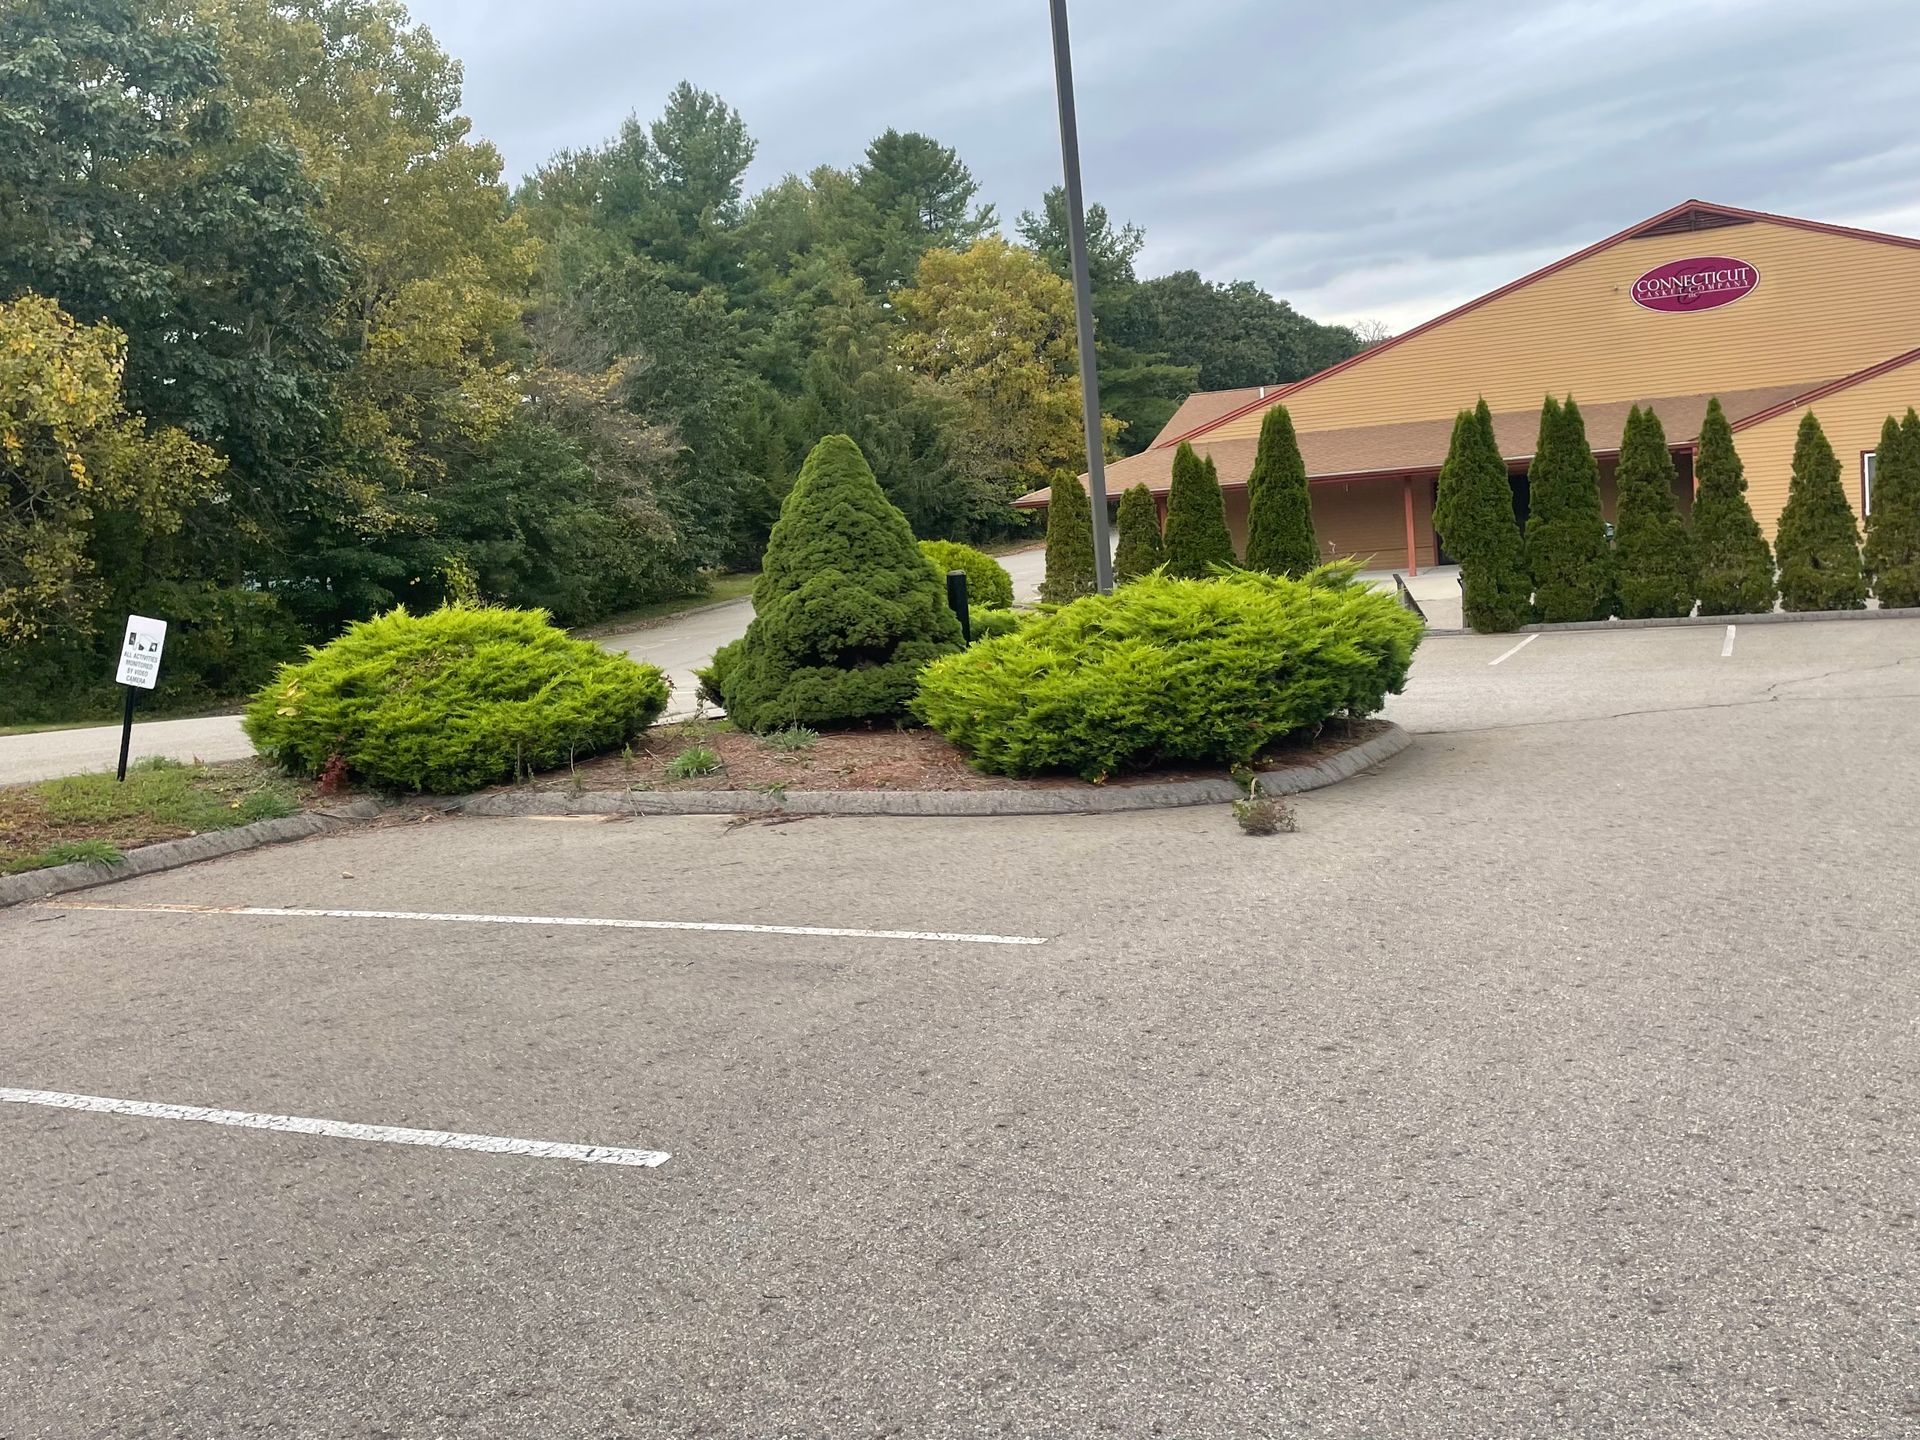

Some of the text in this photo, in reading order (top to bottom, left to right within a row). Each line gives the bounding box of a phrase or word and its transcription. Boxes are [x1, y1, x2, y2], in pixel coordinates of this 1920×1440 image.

[1637, 267, 1749, 293] CONNECTICUT
[1637, 280, 1749, 299] CASKET COMPANY
[133, 653, 158, 663] ACTIVITIES
[126, 659, 153, 670] MONITORED
[134, 669, 149, 677] VIDEO
[126, 675, 146, 684] CAMERA
